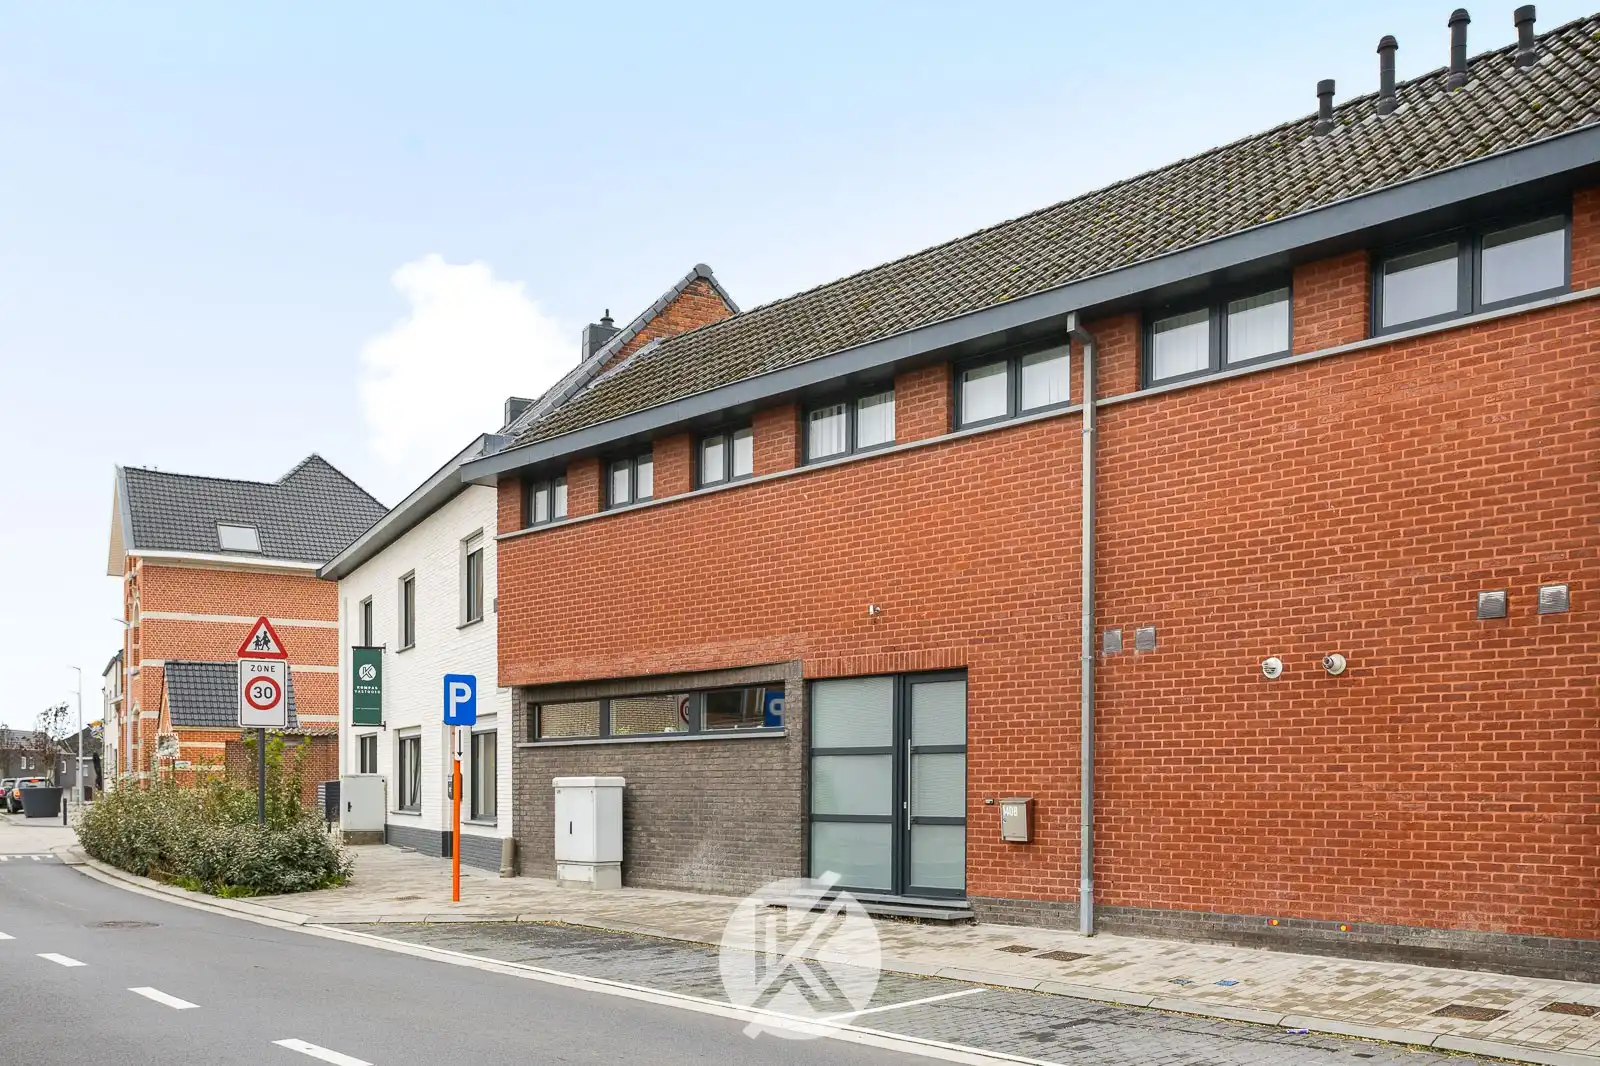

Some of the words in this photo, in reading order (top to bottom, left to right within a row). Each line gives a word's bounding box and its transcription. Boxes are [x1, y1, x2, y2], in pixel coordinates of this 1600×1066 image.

[250, 664, 276, 673] ZONE
[253, 686, 273, 699] 30
[449, 681, 472, 718] P
